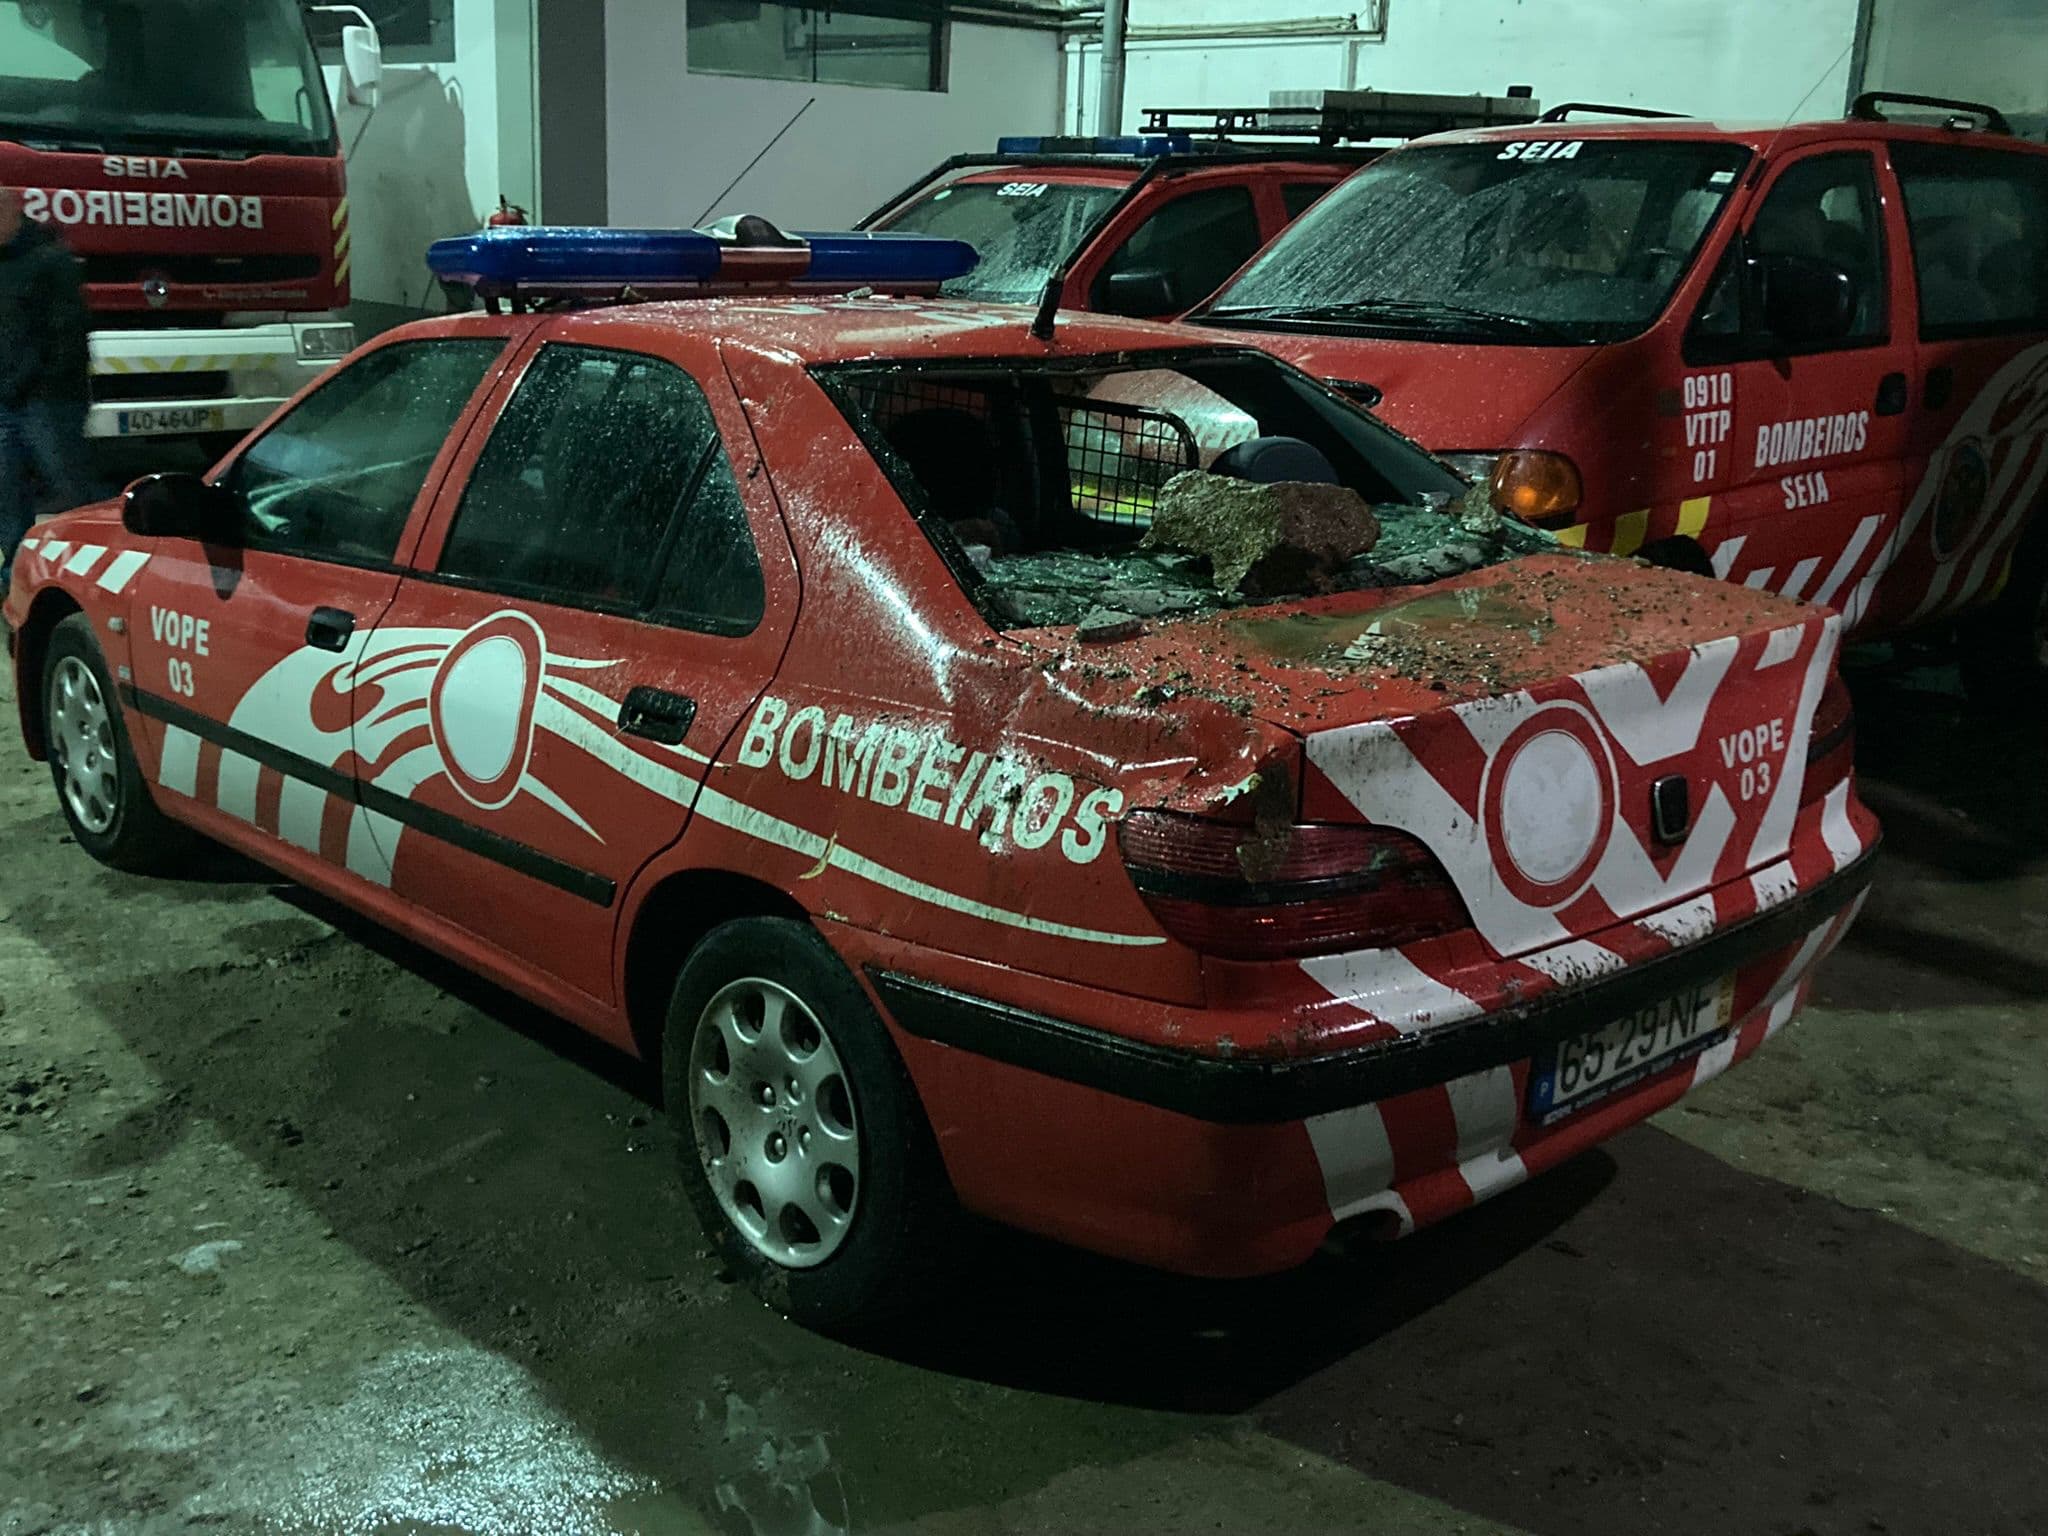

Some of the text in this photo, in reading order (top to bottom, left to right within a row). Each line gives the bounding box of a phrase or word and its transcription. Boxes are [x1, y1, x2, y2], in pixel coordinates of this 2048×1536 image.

[103, 156, 188, 179] SEIA
[1496, 141, 1584, 160] SEIA
[996, 182, 1048, 197] SEIA
[1683, 373, 1732, 408] 0910
[1685, 410, 1731, 447] VTTP
[1755, 410, 1869, 468] BOMBEIROS
[1693, 449, 1716, 483] 01
[1781, 471, 1829, 510] SEIA
[151, 605, 210, 657] VOPE
[168, 657, 194, 698] 03
[1718, 718, 1785, 769] VOPE
[737, 696, 1126, 864] BOMBEIROS
[1741, 769, 1772, 801] 03
